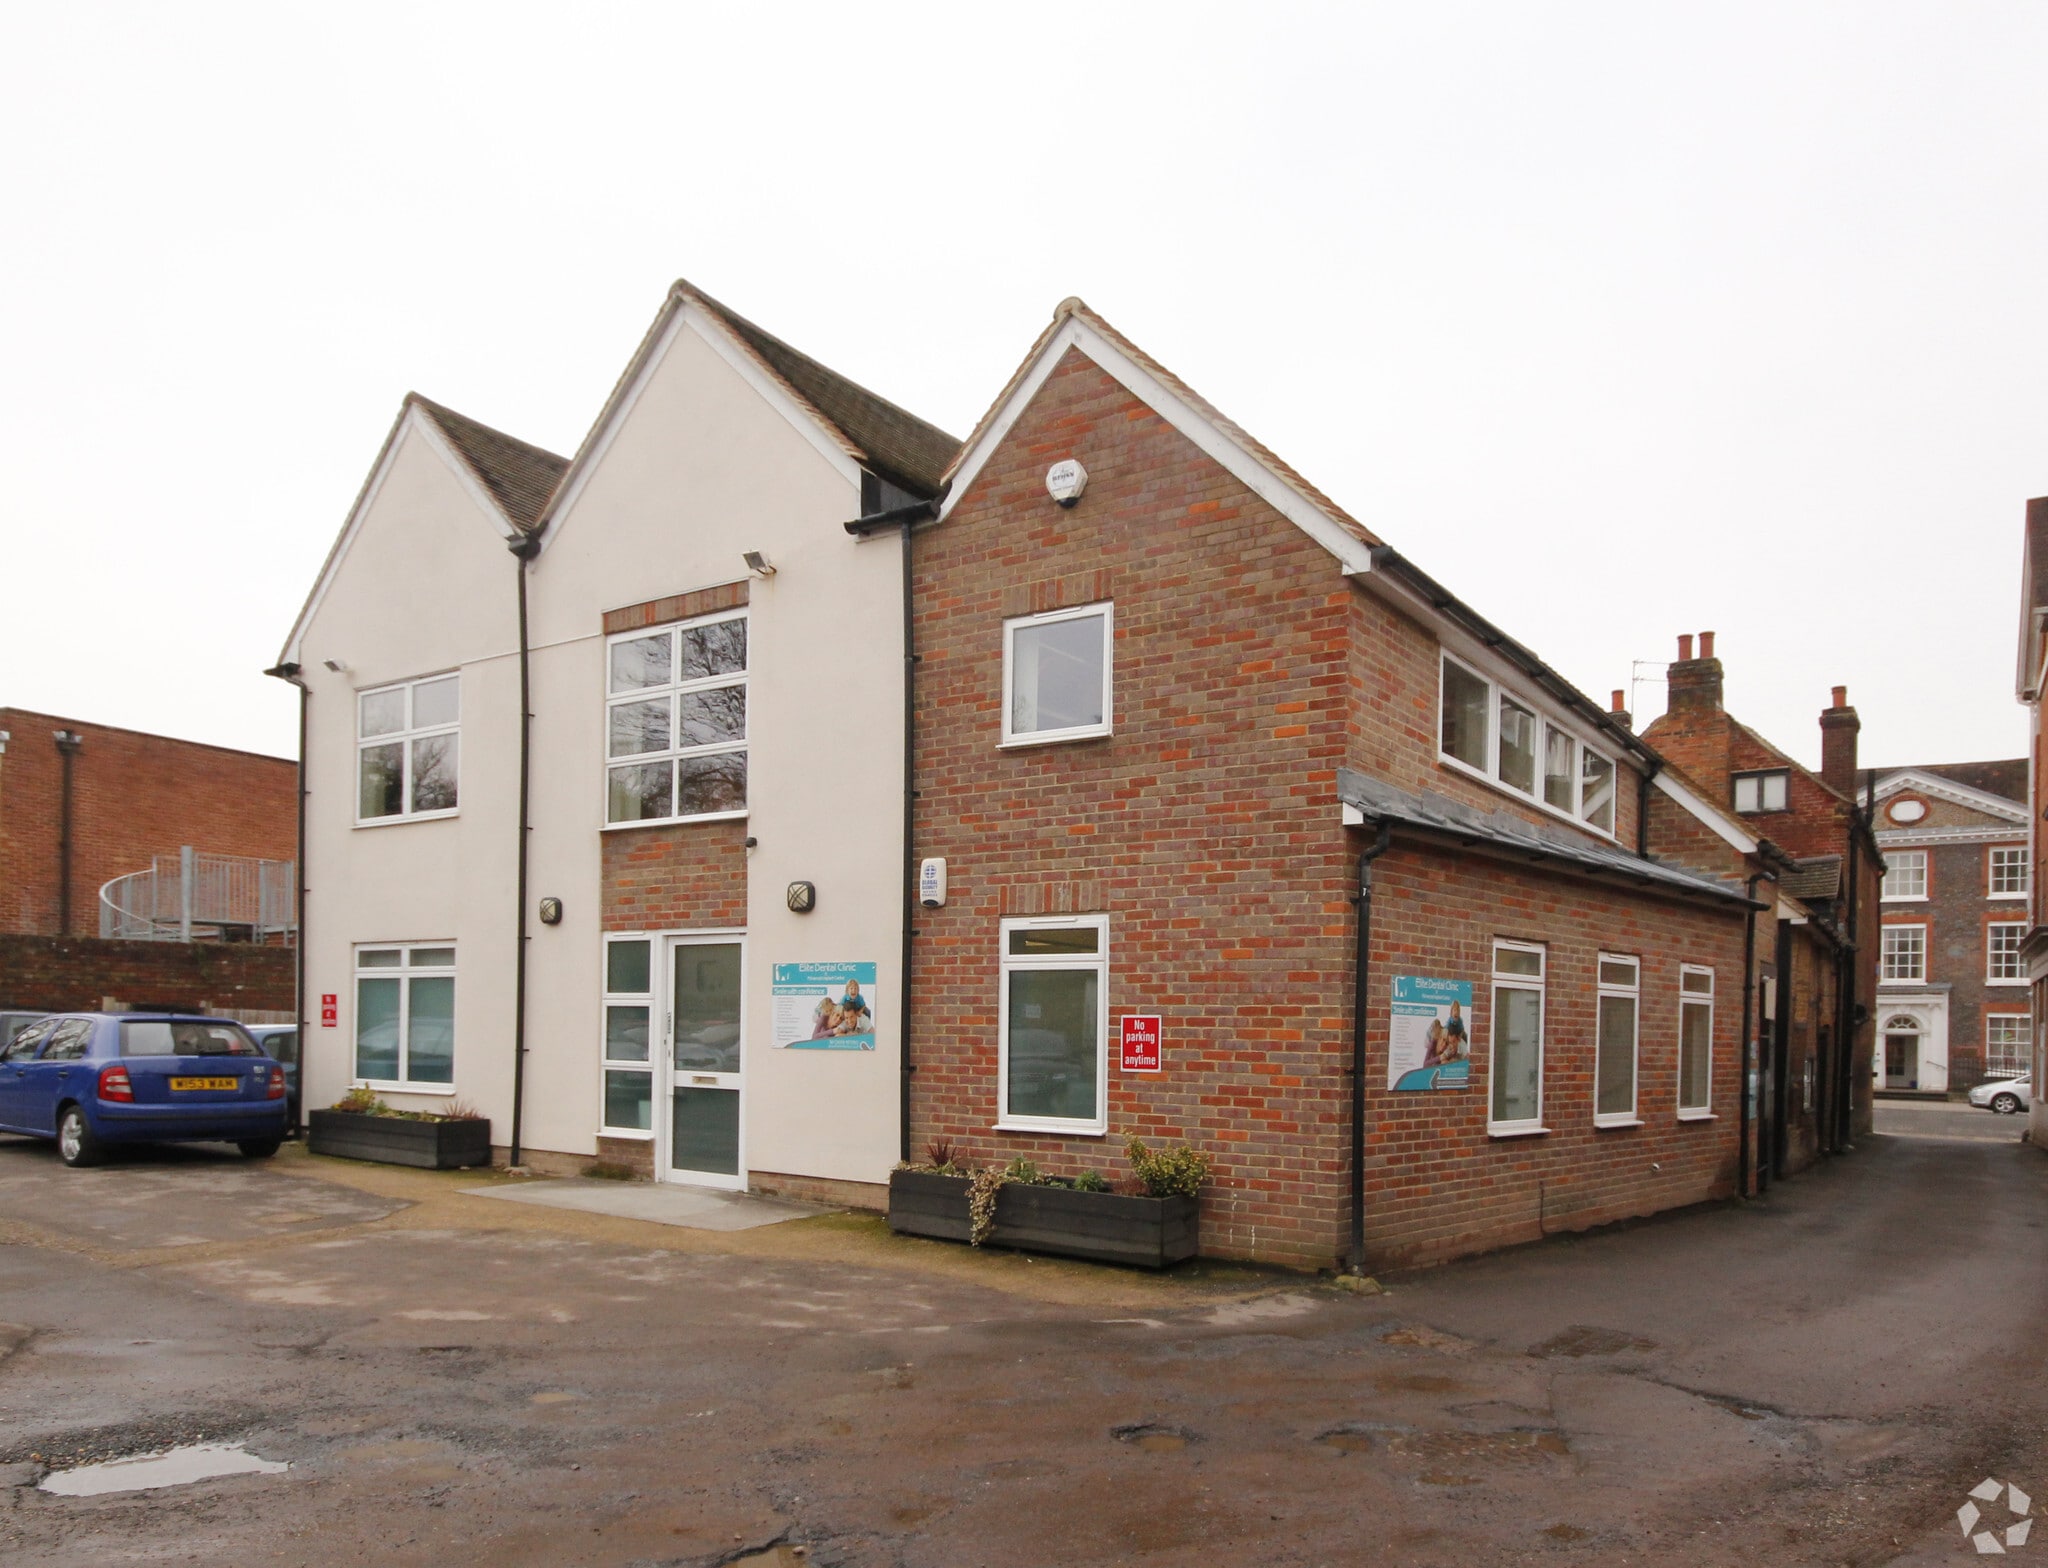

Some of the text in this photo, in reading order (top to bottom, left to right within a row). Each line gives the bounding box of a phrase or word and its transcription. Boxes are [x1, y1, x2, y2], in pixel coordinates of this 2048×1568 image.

[799, 963, 856, 972] Elite Dental Clinic
[1415, 977, 1459, 991] Elite Dental Clinic
[1134, 1019, 1145, 1031] No
[1126, 1032, 1155, 1044] parking
[1135, 1043, 1143, 1053] at
[1125, 1055, 1156, 1067] anytime
[209, 1079, 233, 1088] WAM
